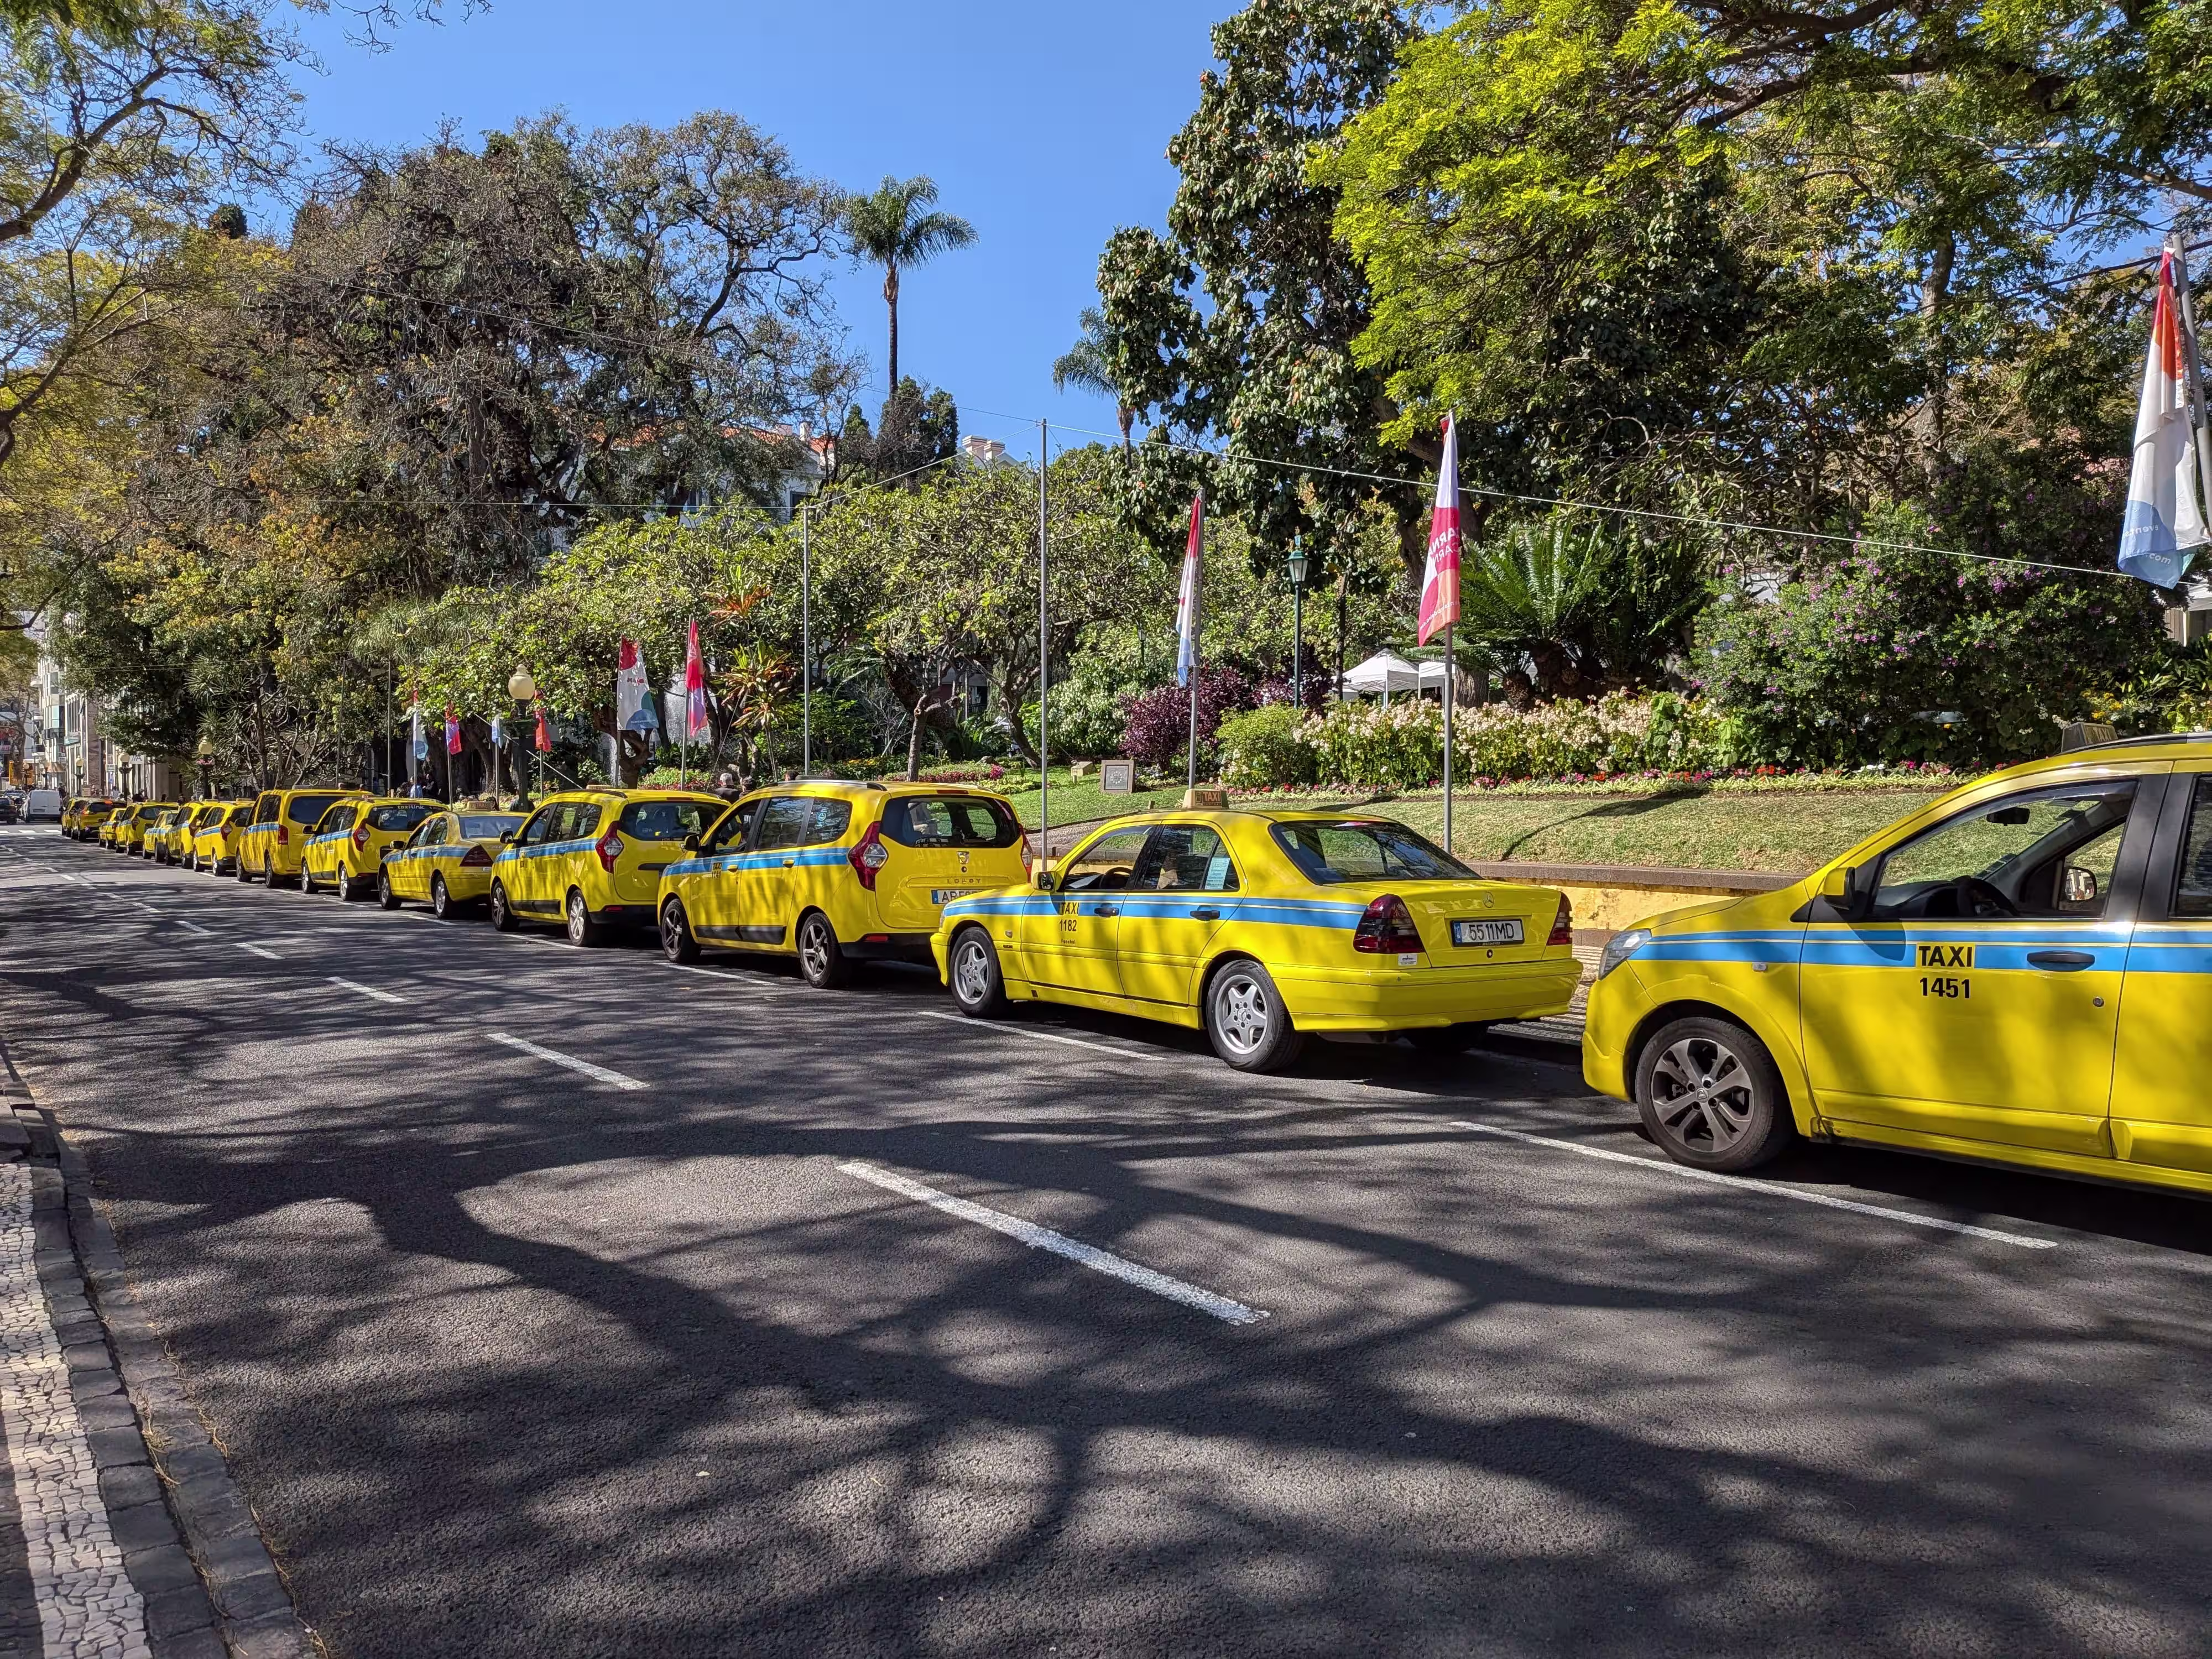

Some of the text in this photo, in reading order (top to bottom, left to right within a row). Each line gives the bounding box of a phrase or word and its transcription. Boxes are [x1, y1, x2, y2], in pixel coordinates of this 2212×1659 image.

[2093, 727, 2112, 742] TAXI
[1203, 792, 1220, 801] TAXI
[1061, 902, 1080, 915] TAXI
[1059, 919, 1077, 932] 1182
[1918, 946, 1973, 967] TAXI
[1919, 977, 1970, 999] 1451
